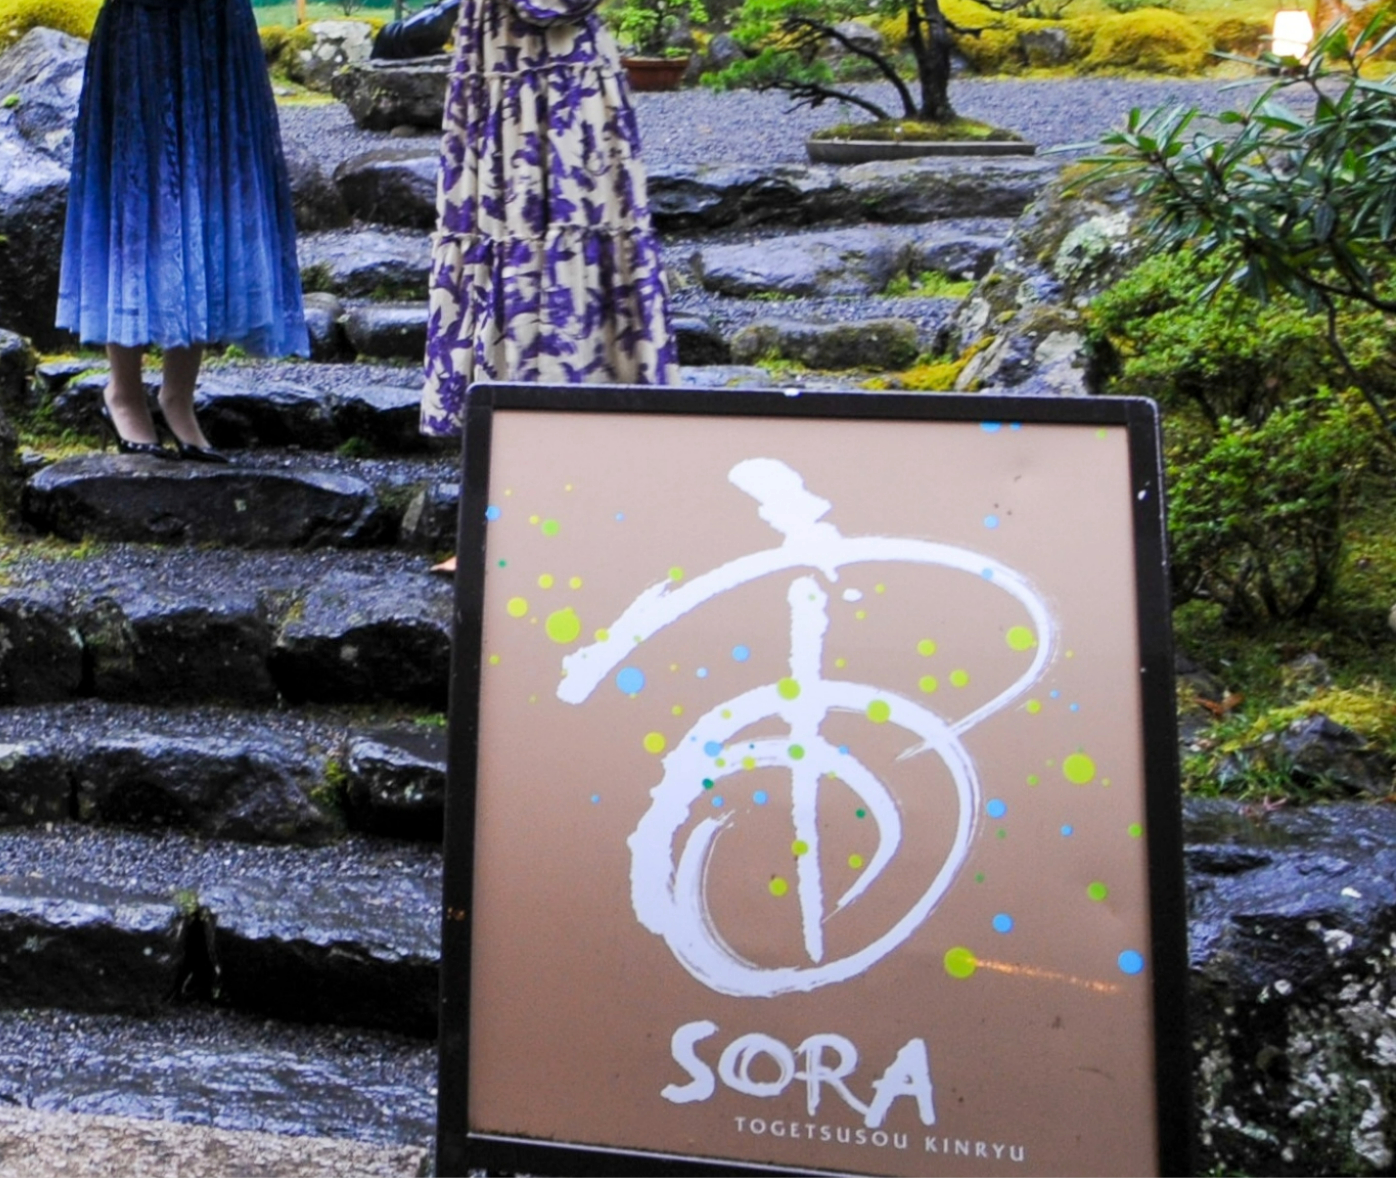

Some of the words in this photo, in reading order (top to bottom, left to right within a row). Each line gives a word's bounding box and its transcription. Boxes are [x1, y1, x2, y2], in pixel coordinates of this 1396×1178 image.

[660, 1020, 936, 1128] SORA
[735, 1116, 907, 1149] TOGETSUSOU
[925, 1136, 1025, 1162] KINRYU
